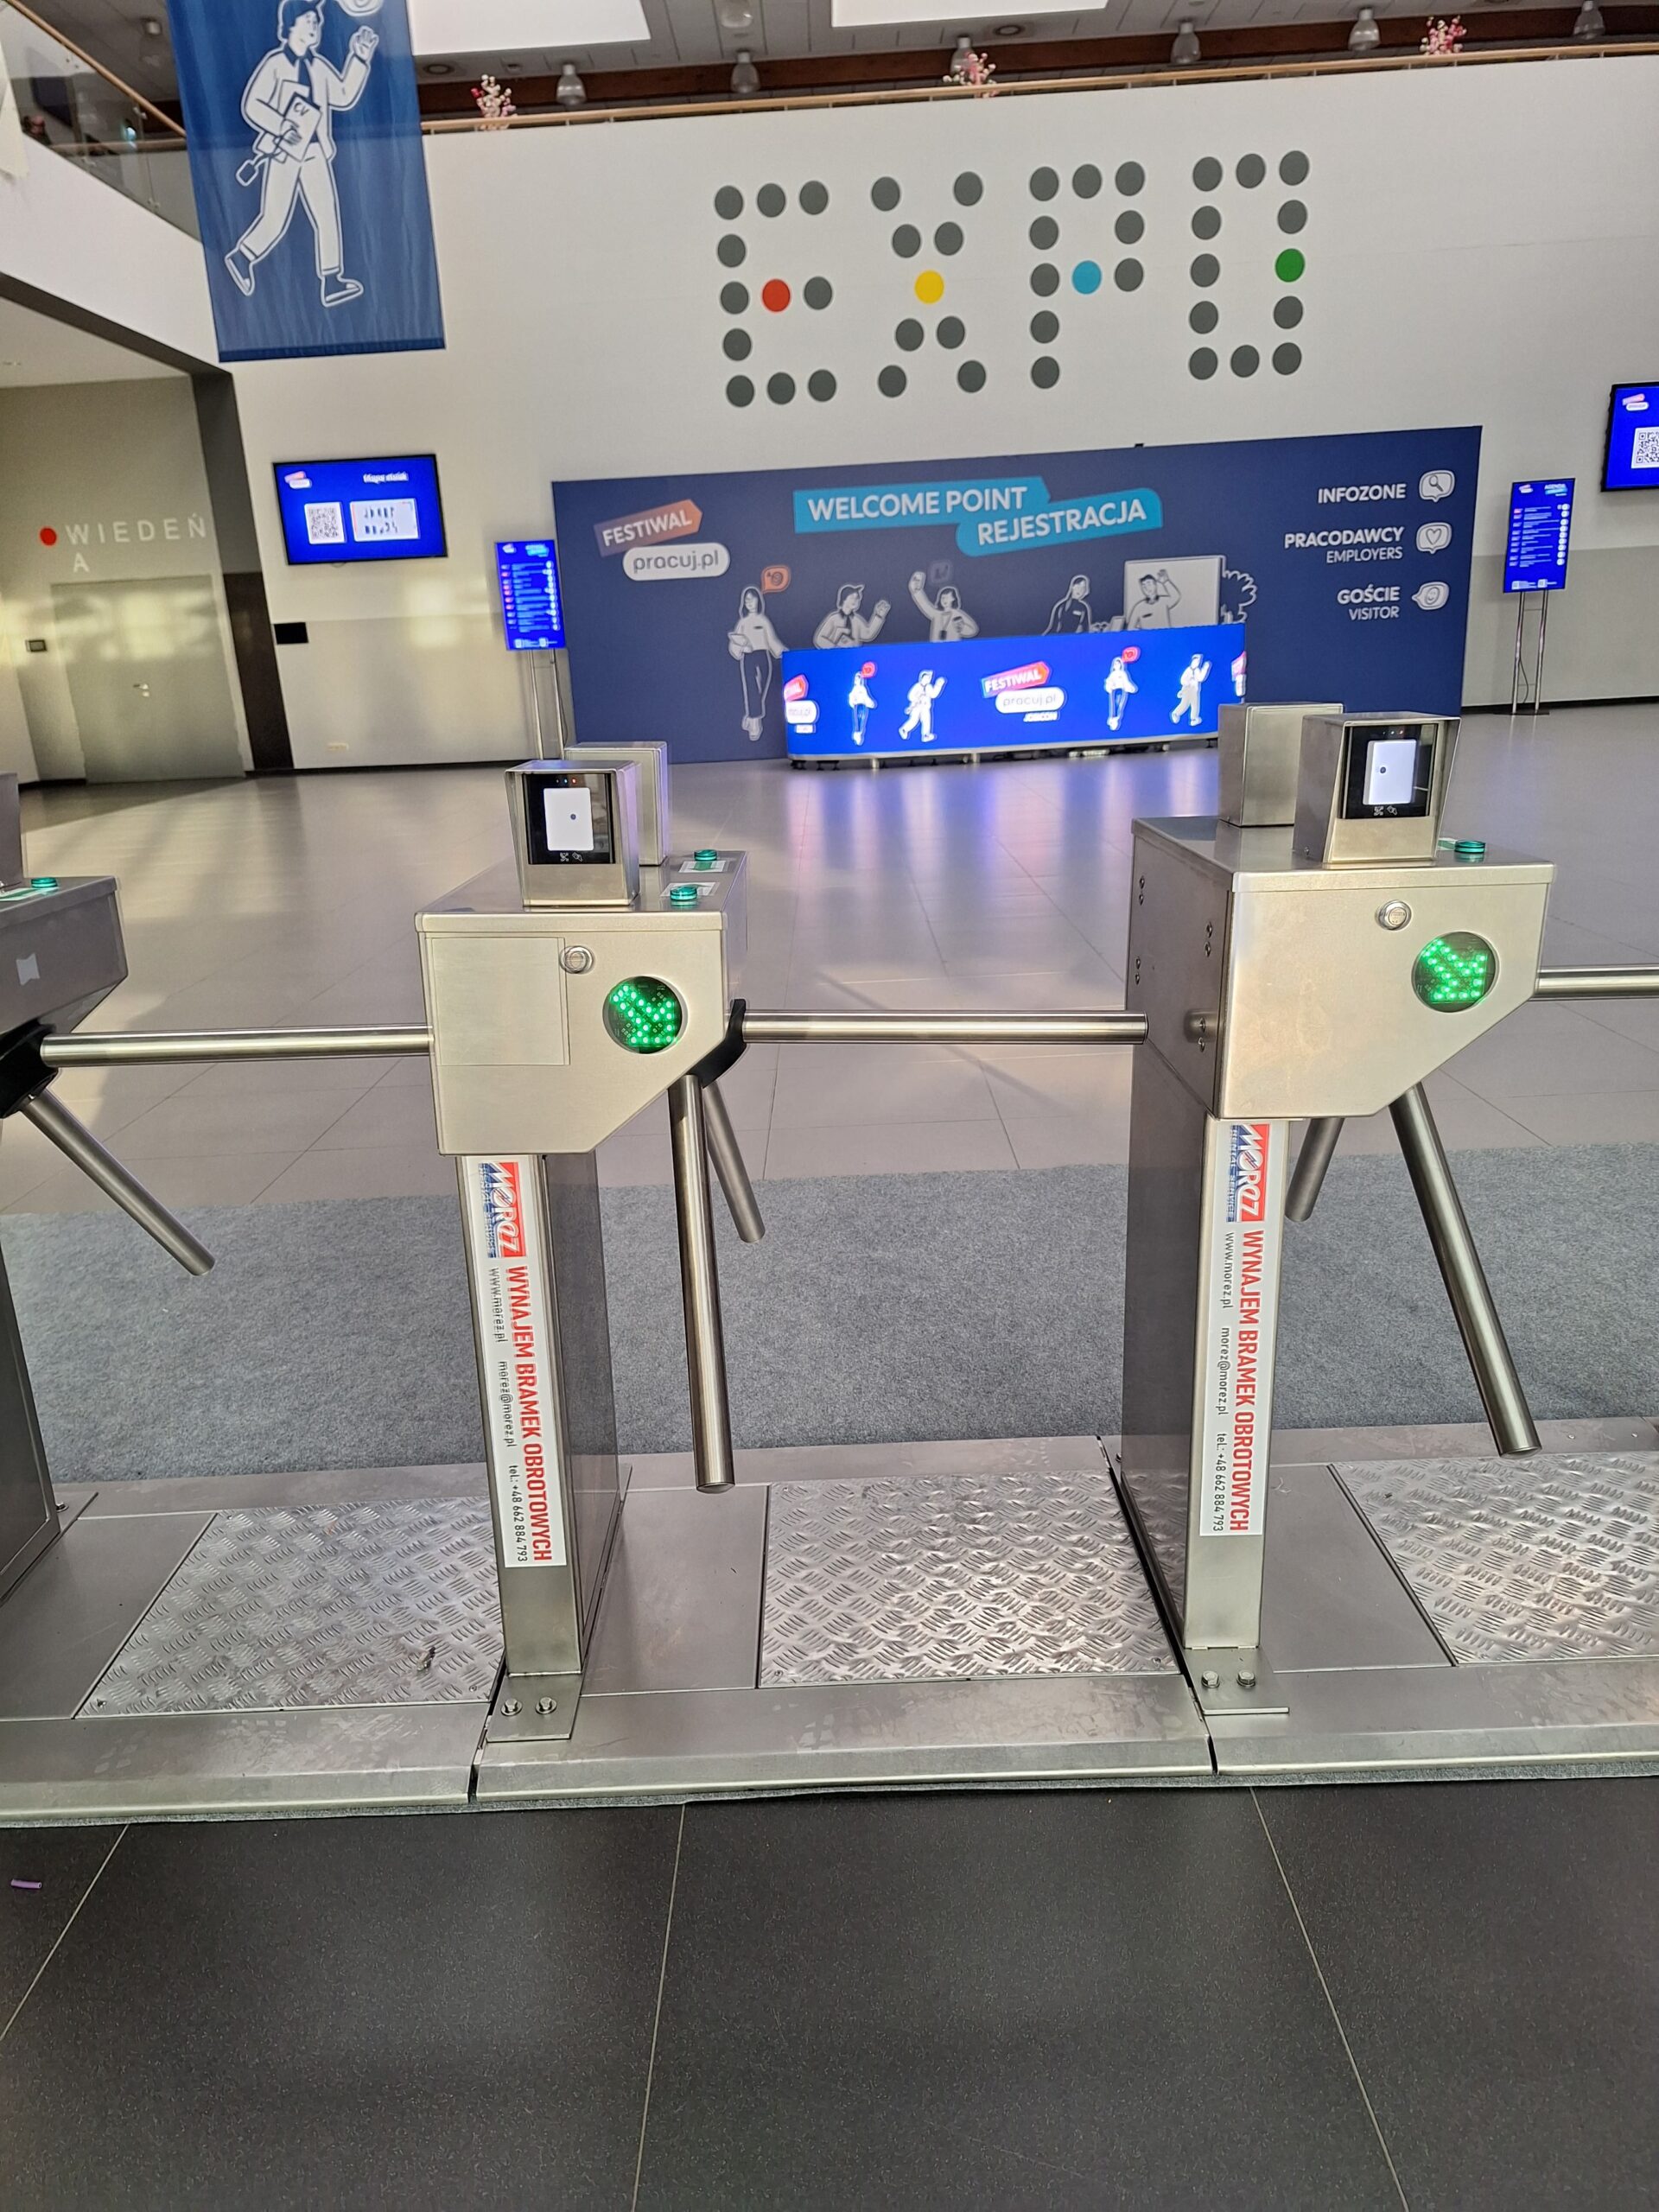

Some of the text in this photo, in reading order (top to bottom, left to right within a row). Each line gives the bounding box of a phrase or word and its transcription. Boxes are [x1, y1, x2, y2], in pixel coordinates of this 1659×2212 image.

[294, 102, 309, 117] CV
[714, 149, 1311, 408] EXPO
[808, 486, 1027, 521] WELCOME POINT
[1318, 483, 1407, 504] INFOZONE
[66, 513, 207, 545] WIEDEŃ
[602, 510, 693, 547] FESTIWAL
[978, 499, 1147, 546] REJESTRACJA
[1284, 526, 1405, 549] PRACODAWCY
[73, 552, 90, 572] A
[633, 550, 719, 575] pracuj.pl
[1326, 546, 1403, 563] EMPLOYERS
[1337, 584, 1401, 605] GOŚCIE
[1349, 606, 1400, 620] VISITOR
[984, 669, 1042, 693] FESTIWAL
[1220, 1232, 1234, 1308] www.morez.pl
[489, 1268, 508, 1342] www.morez.pl
[1216, 1327, 1230, 1415] morez@morez.pl
[1230, 1230, 1265, 1531] WYNAJEM BRAMEK OBROTOWYCH
[498, 1361, 517, 1447] morez@morez.pl
[506, 1266, 552, 1561] WYNAJEM BRAMEK OBROTOWYCH
[1216, 1453, 1226, 1471] +48
[512, 1485, 523, 1503] +48
[1215, 1475, 1226, 1491] 662
[1214, 1493, 1225, 1512] 884
[512, 1506, 524, 1522] 662
[1213, 1515, 1224, 1531] 793
[514, 1523, 526, 1543] 884
[517, 1545, 528, 1561] 793
